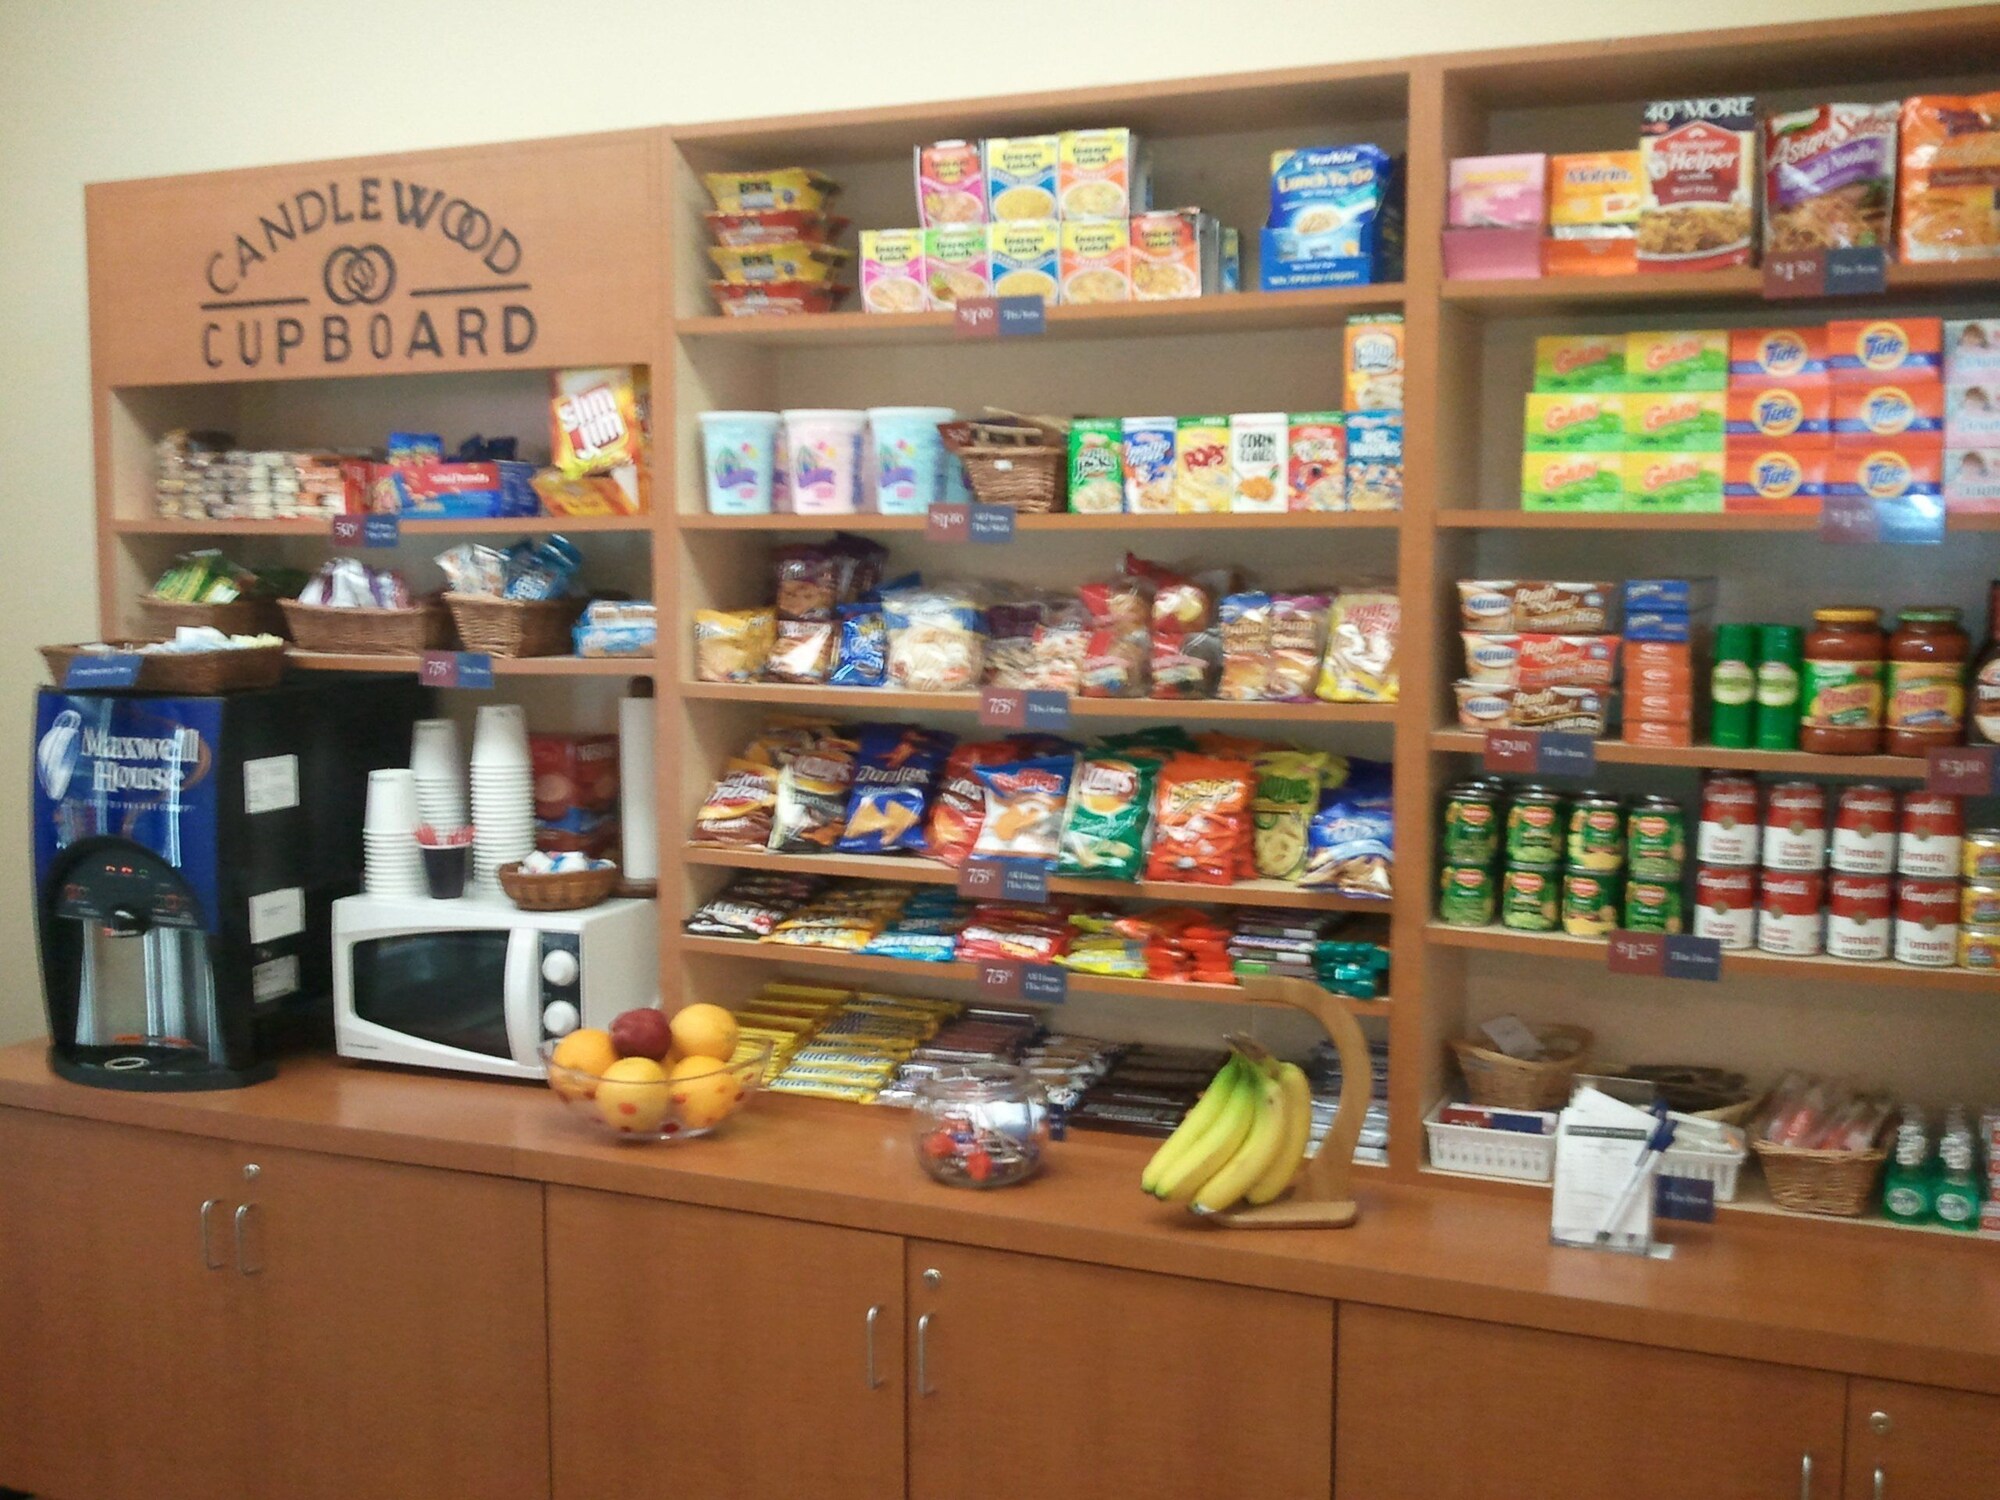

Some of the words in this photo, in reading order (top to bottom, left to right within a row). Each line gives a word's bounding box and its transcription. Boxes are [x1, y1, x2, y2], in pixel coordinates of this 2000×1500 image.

[1683, 97, 1754, 118] MORE
[1668, 151, 1739, 174] Helper
[206, 178, 522, 295] CANDLEWOOD
[202, 304, 538, 368] CUPBOARD
[1864, 334, 1903, 358] Tide
[1765, 341, 1800, 365] Tide
[1760, 401, 1797, 426] Tide
[1869, 399, 1908, 424] Tide
[1759, 463, 1796, 488] Tide
[1867, 463, 1904, 488] Tide
[81, 726, 200, 763] Maxwell
[92, 759, 186, 793] House
